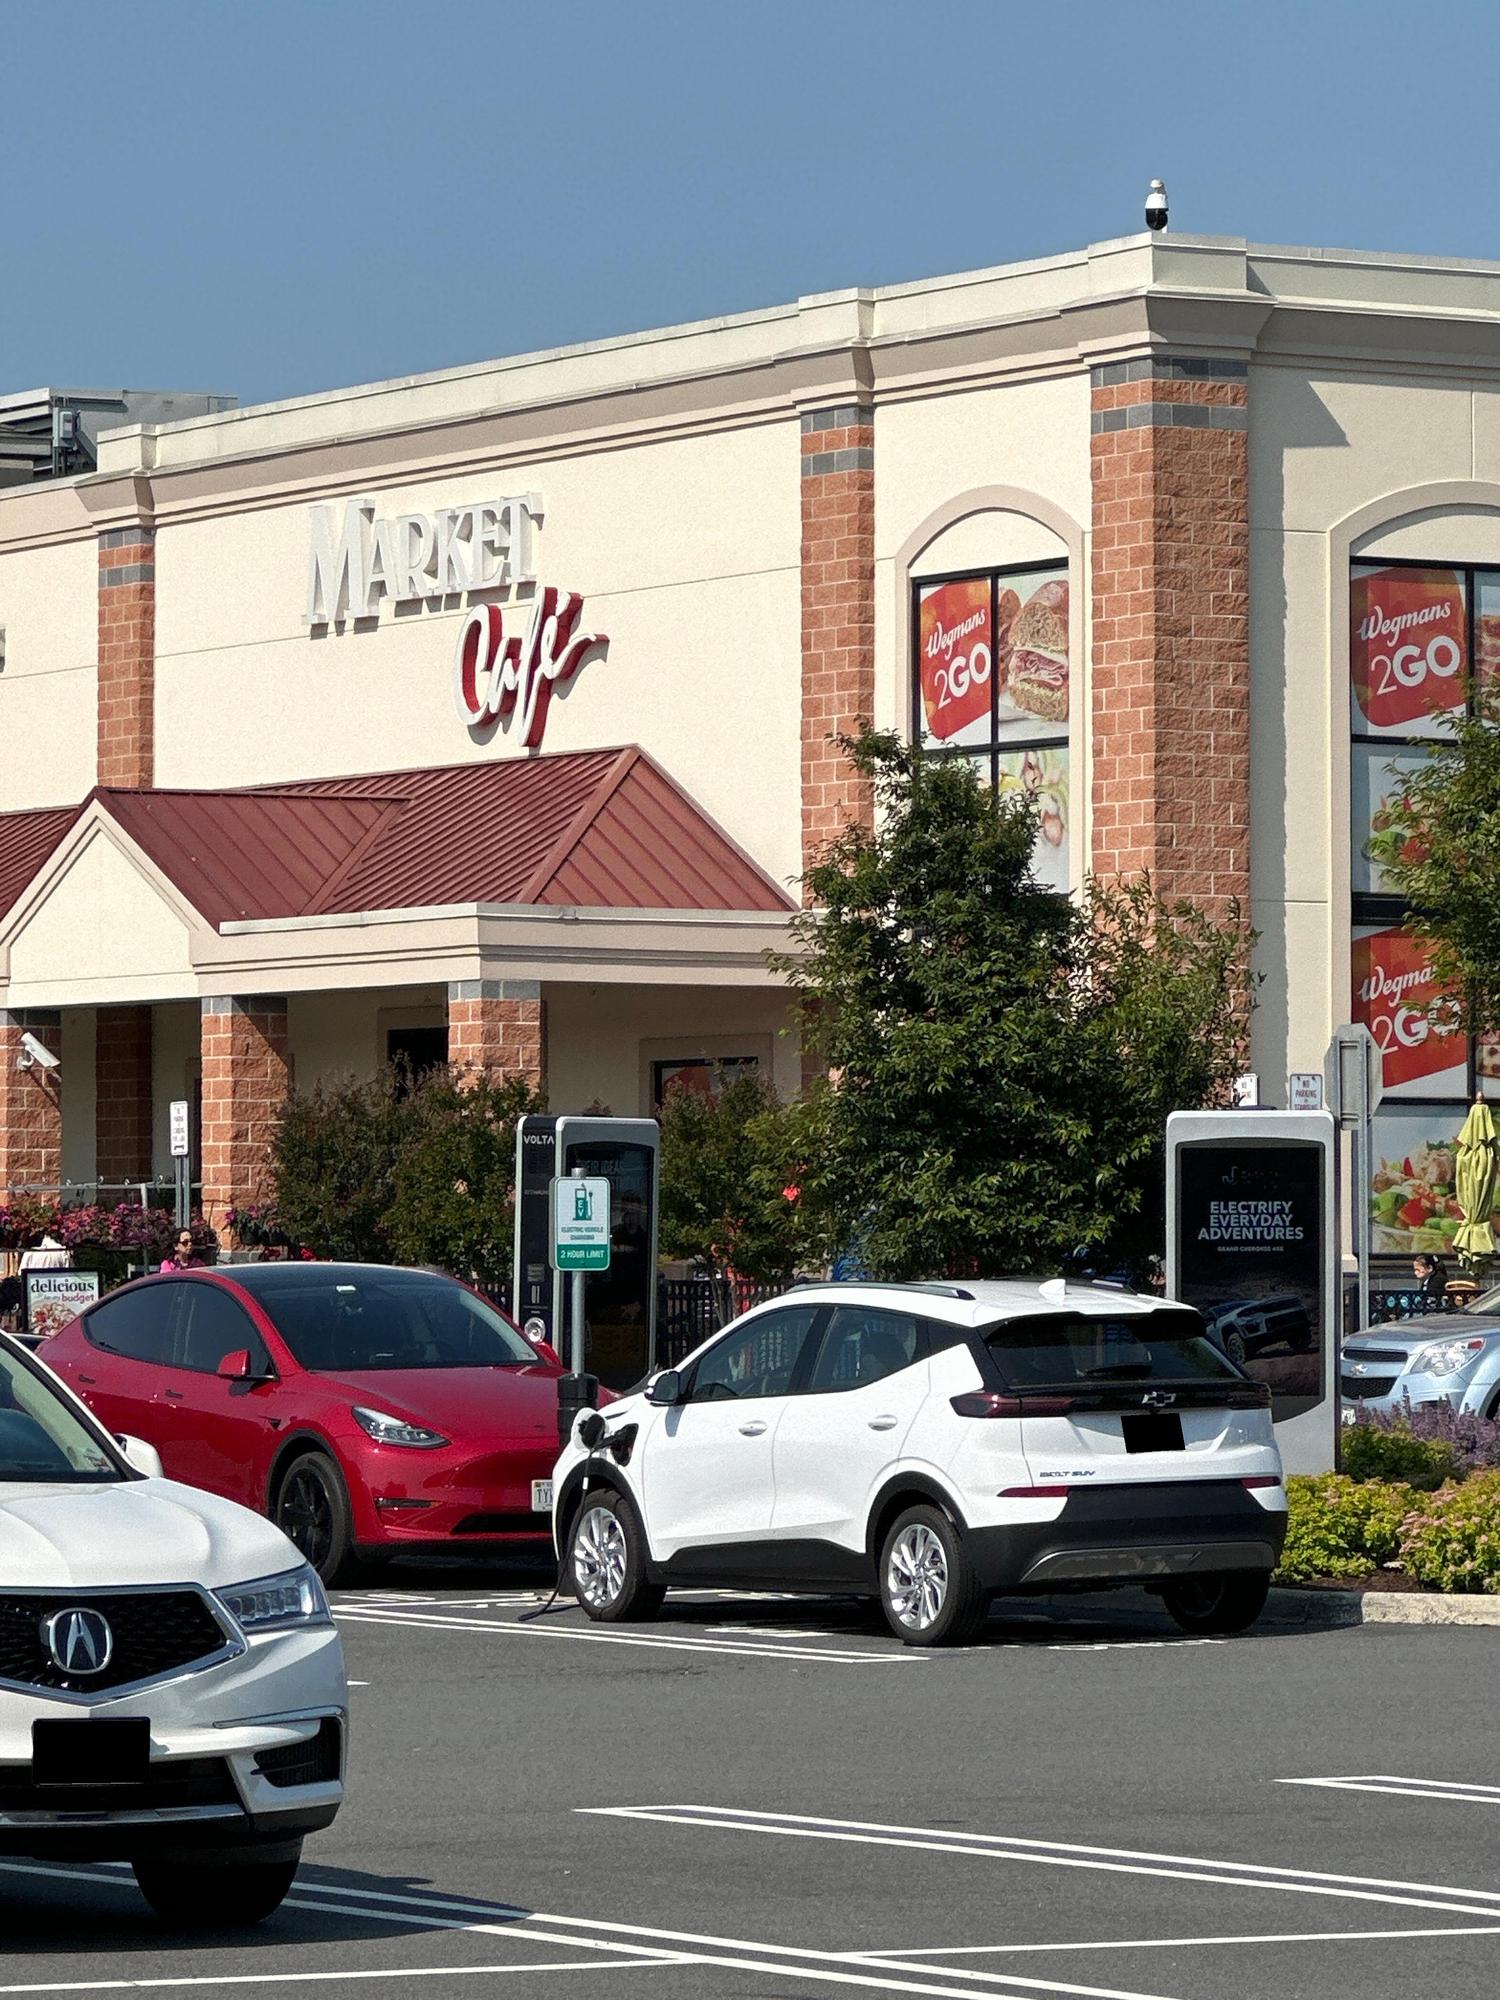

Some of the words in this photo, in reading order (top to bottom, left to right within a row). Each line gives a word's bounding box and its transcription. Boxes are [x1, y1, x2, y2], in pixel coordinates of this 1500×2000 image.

[1356, 601, 1451, 648] Wegmans
[925, 609, 986, 661] Wegmans
[1370, 635, 1461, 696] 2GO
[934, 642, 991, 710] 2GO
[523, 1135, 554, 1145] VOLTA
[1210, 1201, 1293, 1214] ELECTRIFY
[1210, 1214, 1293, 1227] EVERYDAY
[1198, 1227, 1304, 1240] ADVENTURES
[560, 1250, 566, 1258] 2
[567, 1250, 585, 1258] HOUR
[586, 1250, 605, 1258] LIMIT
[30, 1278, 95, 1293] delicious
[61, 1293, 95, 1304] budget
